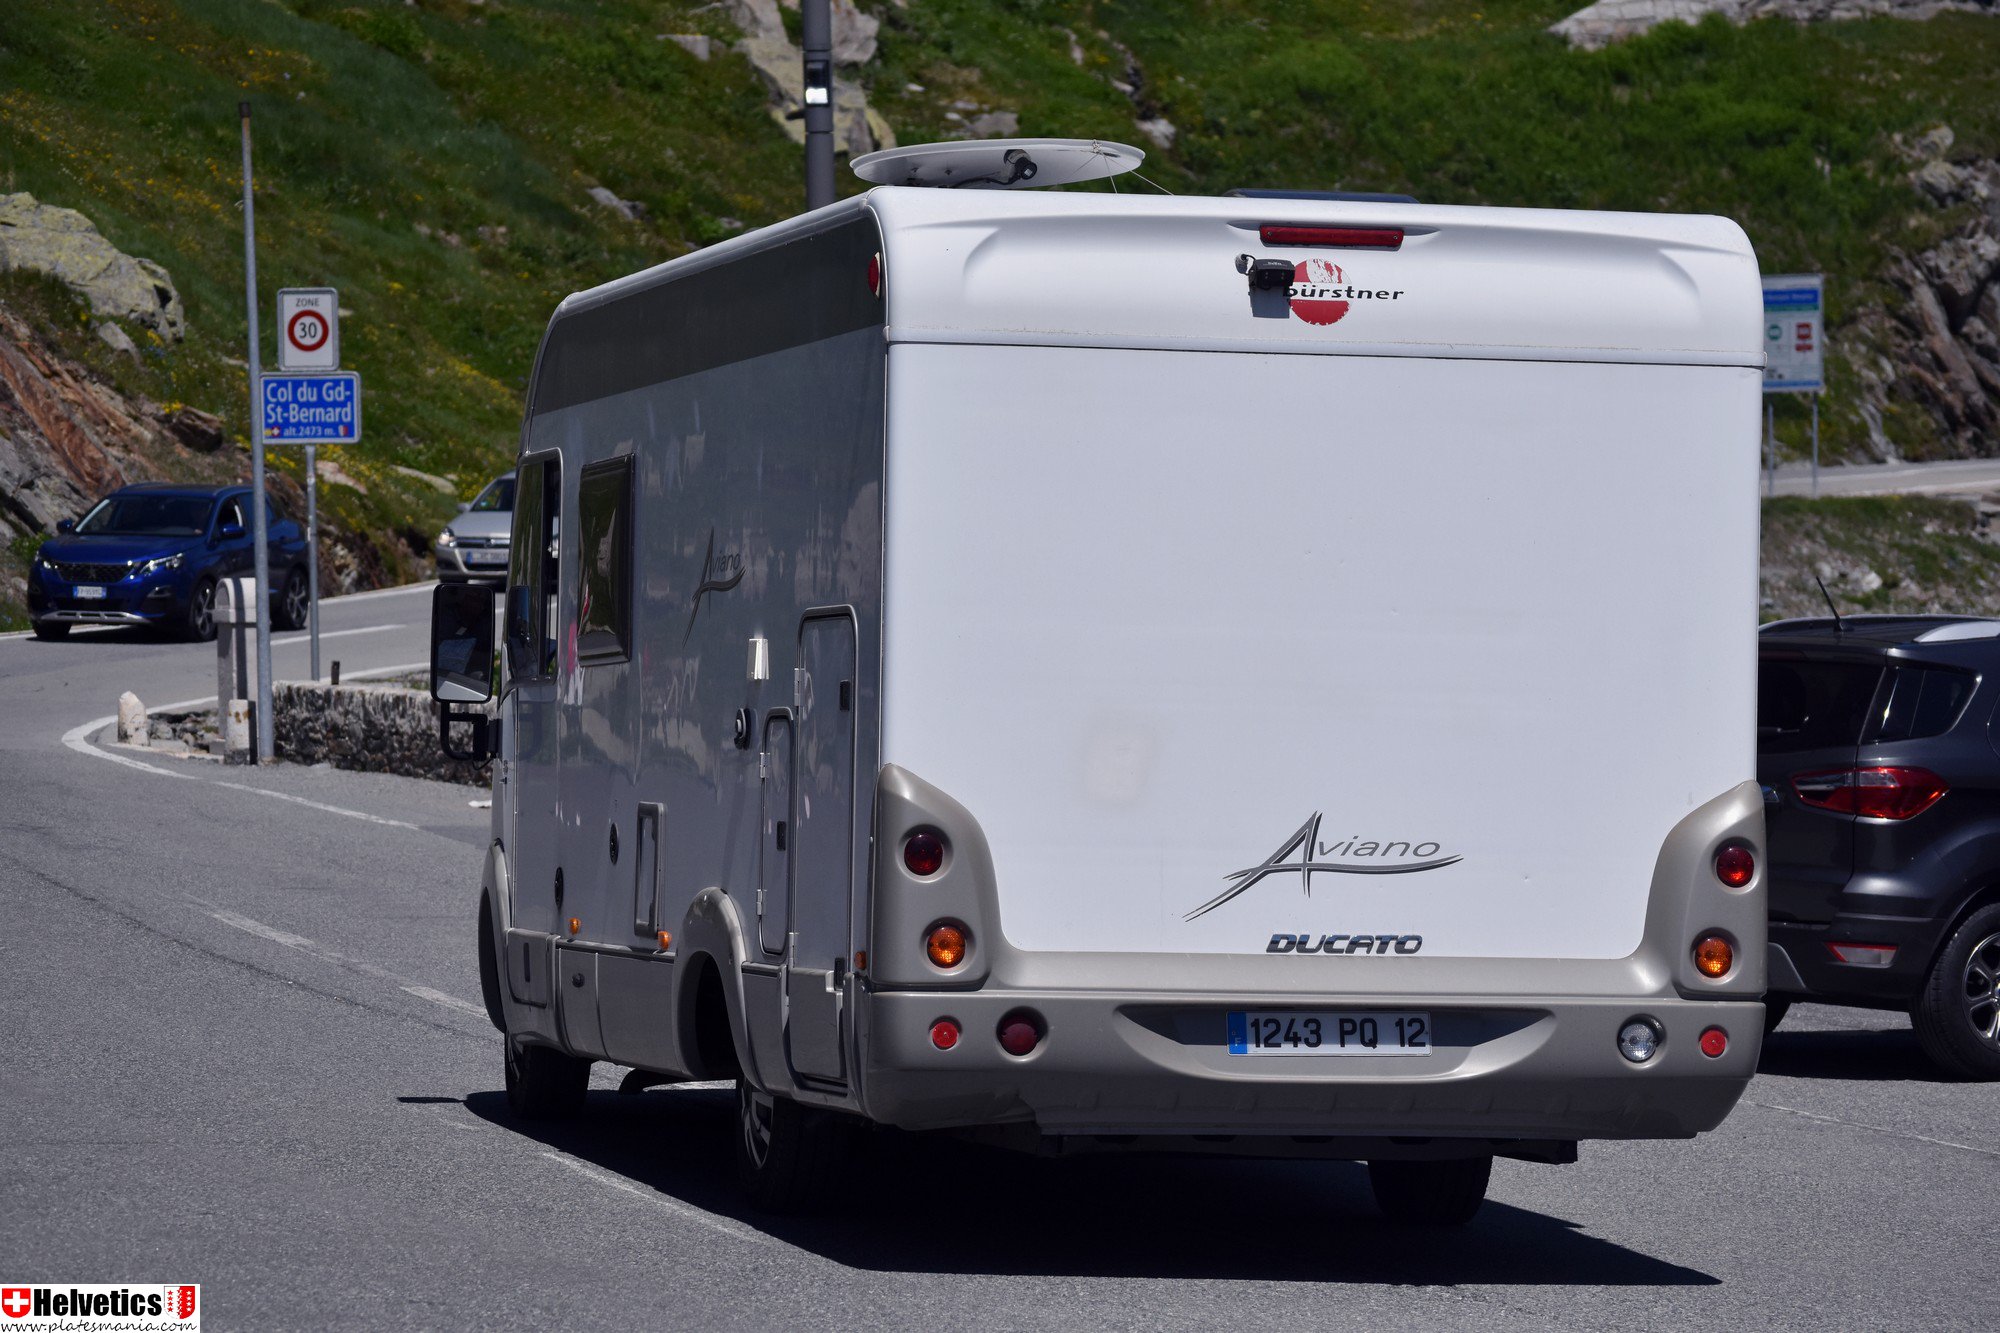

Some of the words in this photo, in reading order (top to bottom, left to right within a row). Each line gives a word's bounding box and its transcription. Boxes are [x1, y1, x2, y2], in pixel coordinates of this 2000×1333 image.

[295, 297, 320, 307] ZONE
[299, 322, 317, 339] 30
[266, 381, 292, 402] Col
[297, 381, 317, 402] du
[322, 381, 351, 402] Gd-
[266, 401, 352, 423] St-Bernard
[1182, 810, 1464, 922] Aviano
[1266, 933, 1423, 955] DUCATO
[1250, 1017, 1322, 1047] 1243
[1338, 1017, 1377, 1049] PQ
[1395, 1017, 1426, 1047] 12
